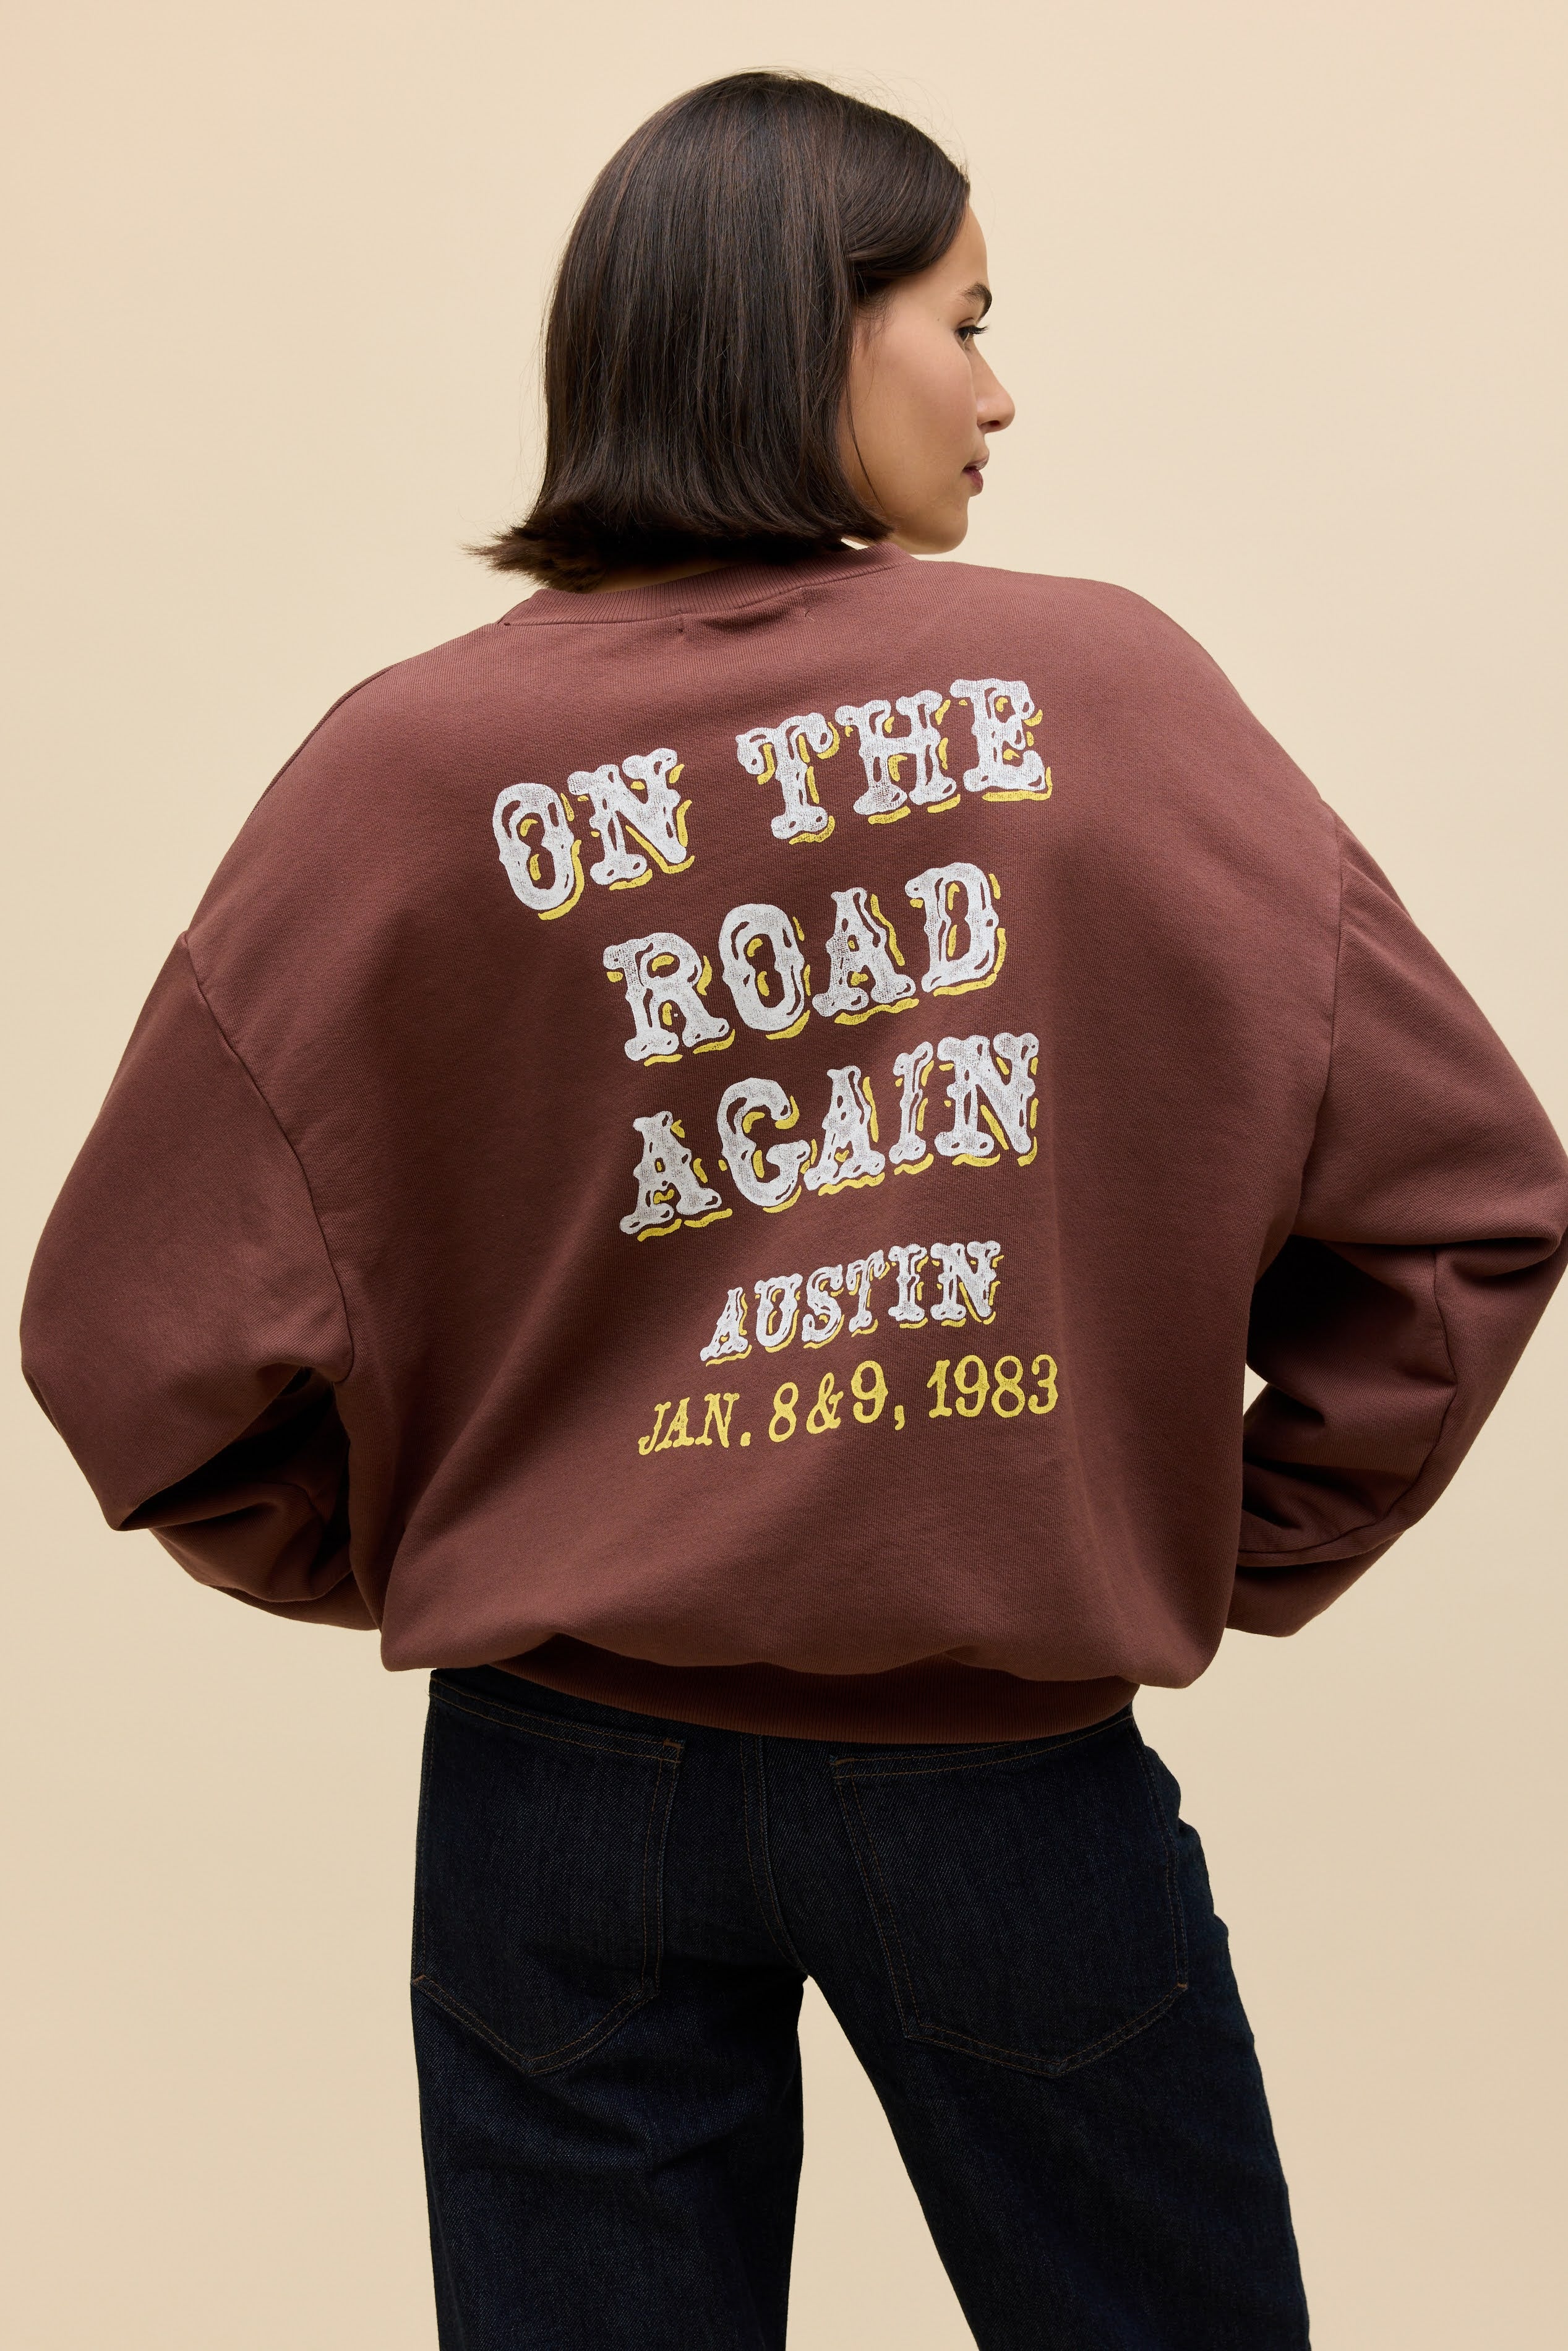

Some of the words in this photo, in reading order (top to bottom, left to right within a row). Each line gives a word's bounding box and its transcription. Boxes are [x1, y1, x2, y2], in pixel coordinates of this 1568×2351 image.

[492, 747, 696, 921] ON
[735, 677, 1054, 846] THE
[602, 862, 1008, 1067] ROAD
[619, 1032, 1040, 1242] AGAIN
[638, 1392, 753, 1456] JAN.
[926, 1354, 1060, 1419] 1983
[700, 1240, 1005, 1368] AUSTIN
